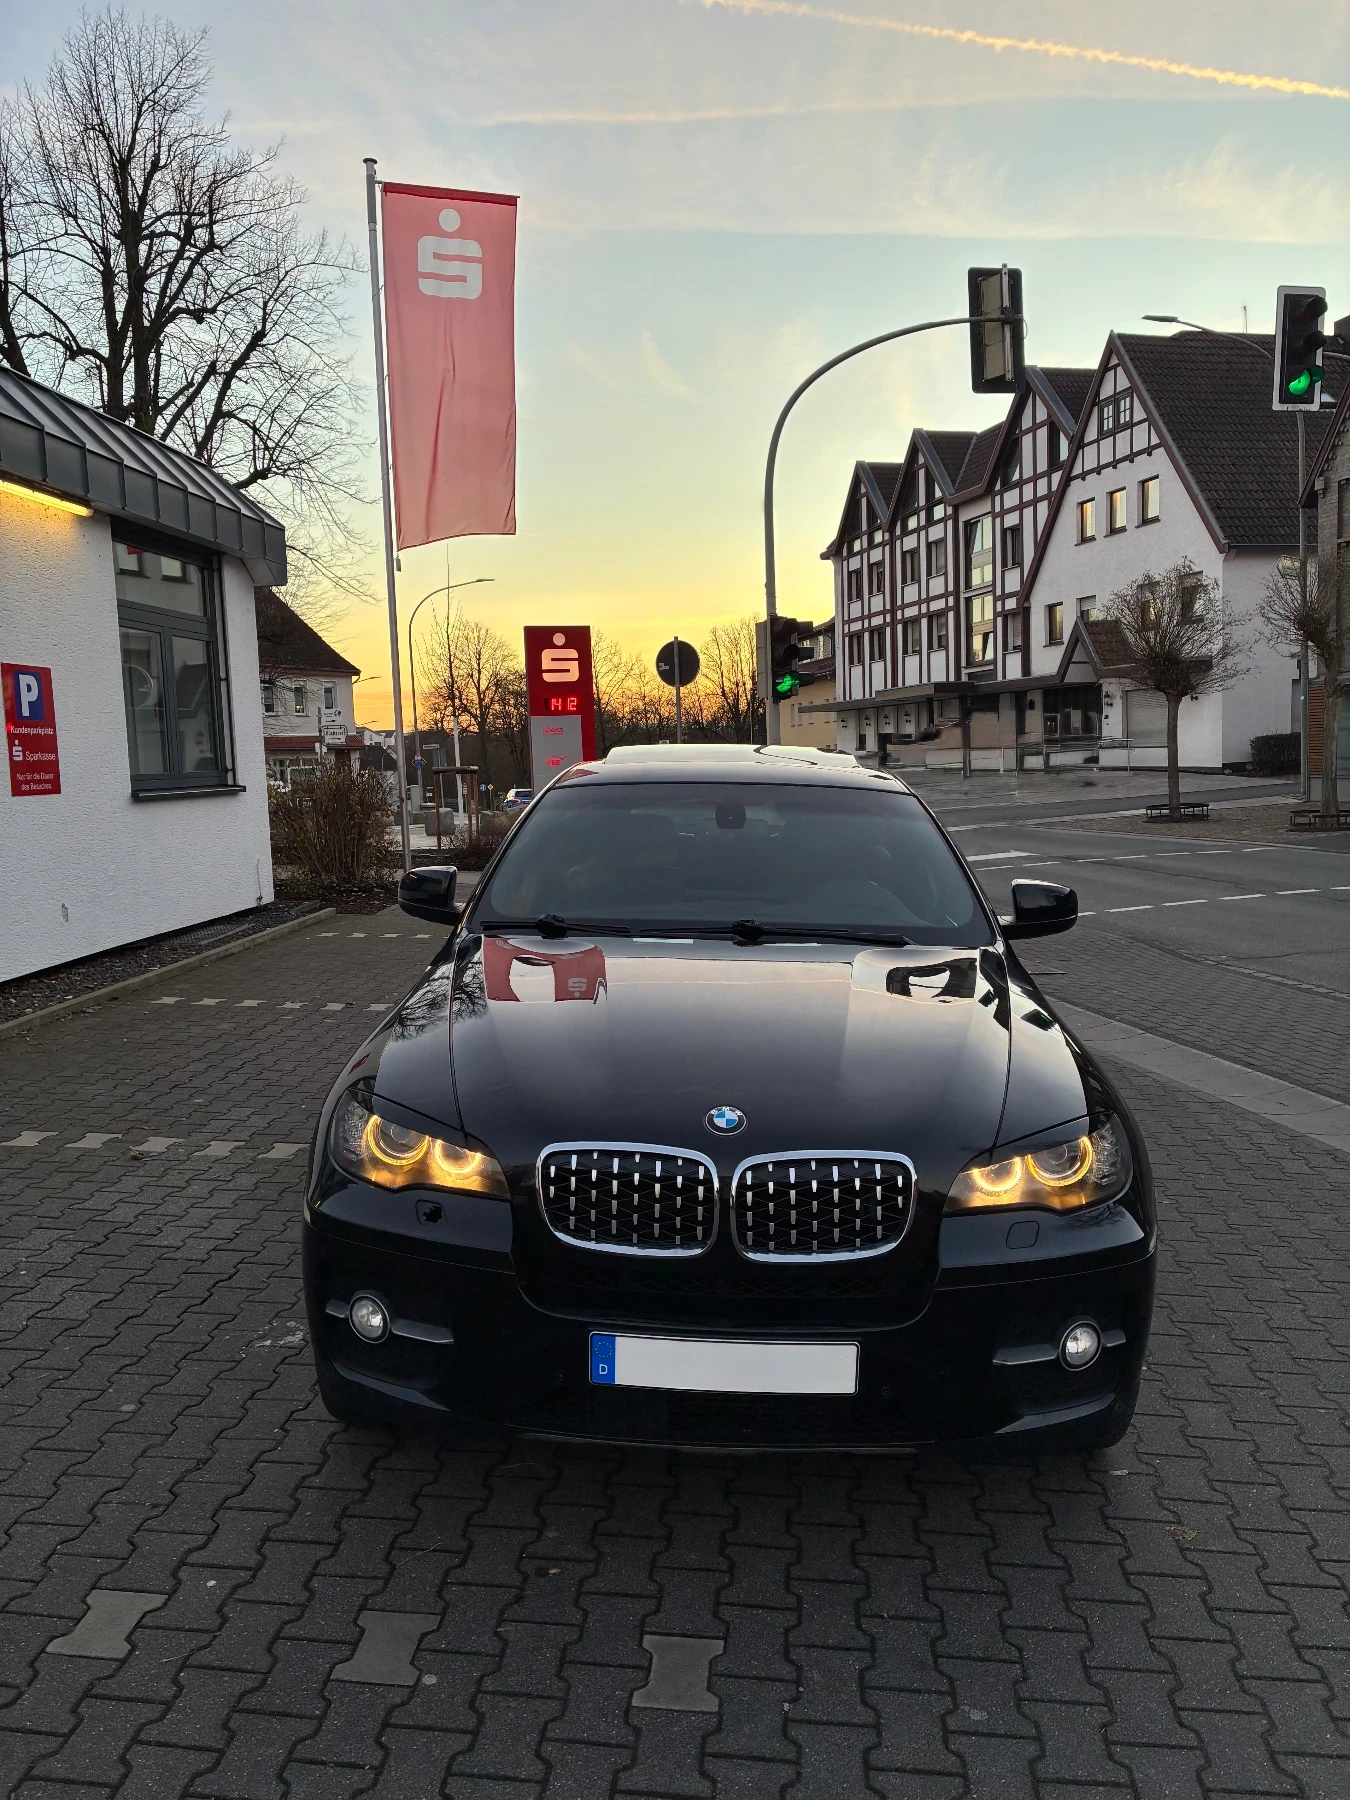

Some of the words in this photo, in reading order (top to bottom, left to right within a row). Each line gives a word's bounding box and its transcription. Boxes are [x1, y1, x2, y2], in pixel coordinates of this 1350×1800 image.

[19, 674, 39, 717] P
[10, 726, 54, 735] Kundenparkplatz
[25, 751, 56, 762] Sparkasse
[599, 1364, 608, 1375] D
